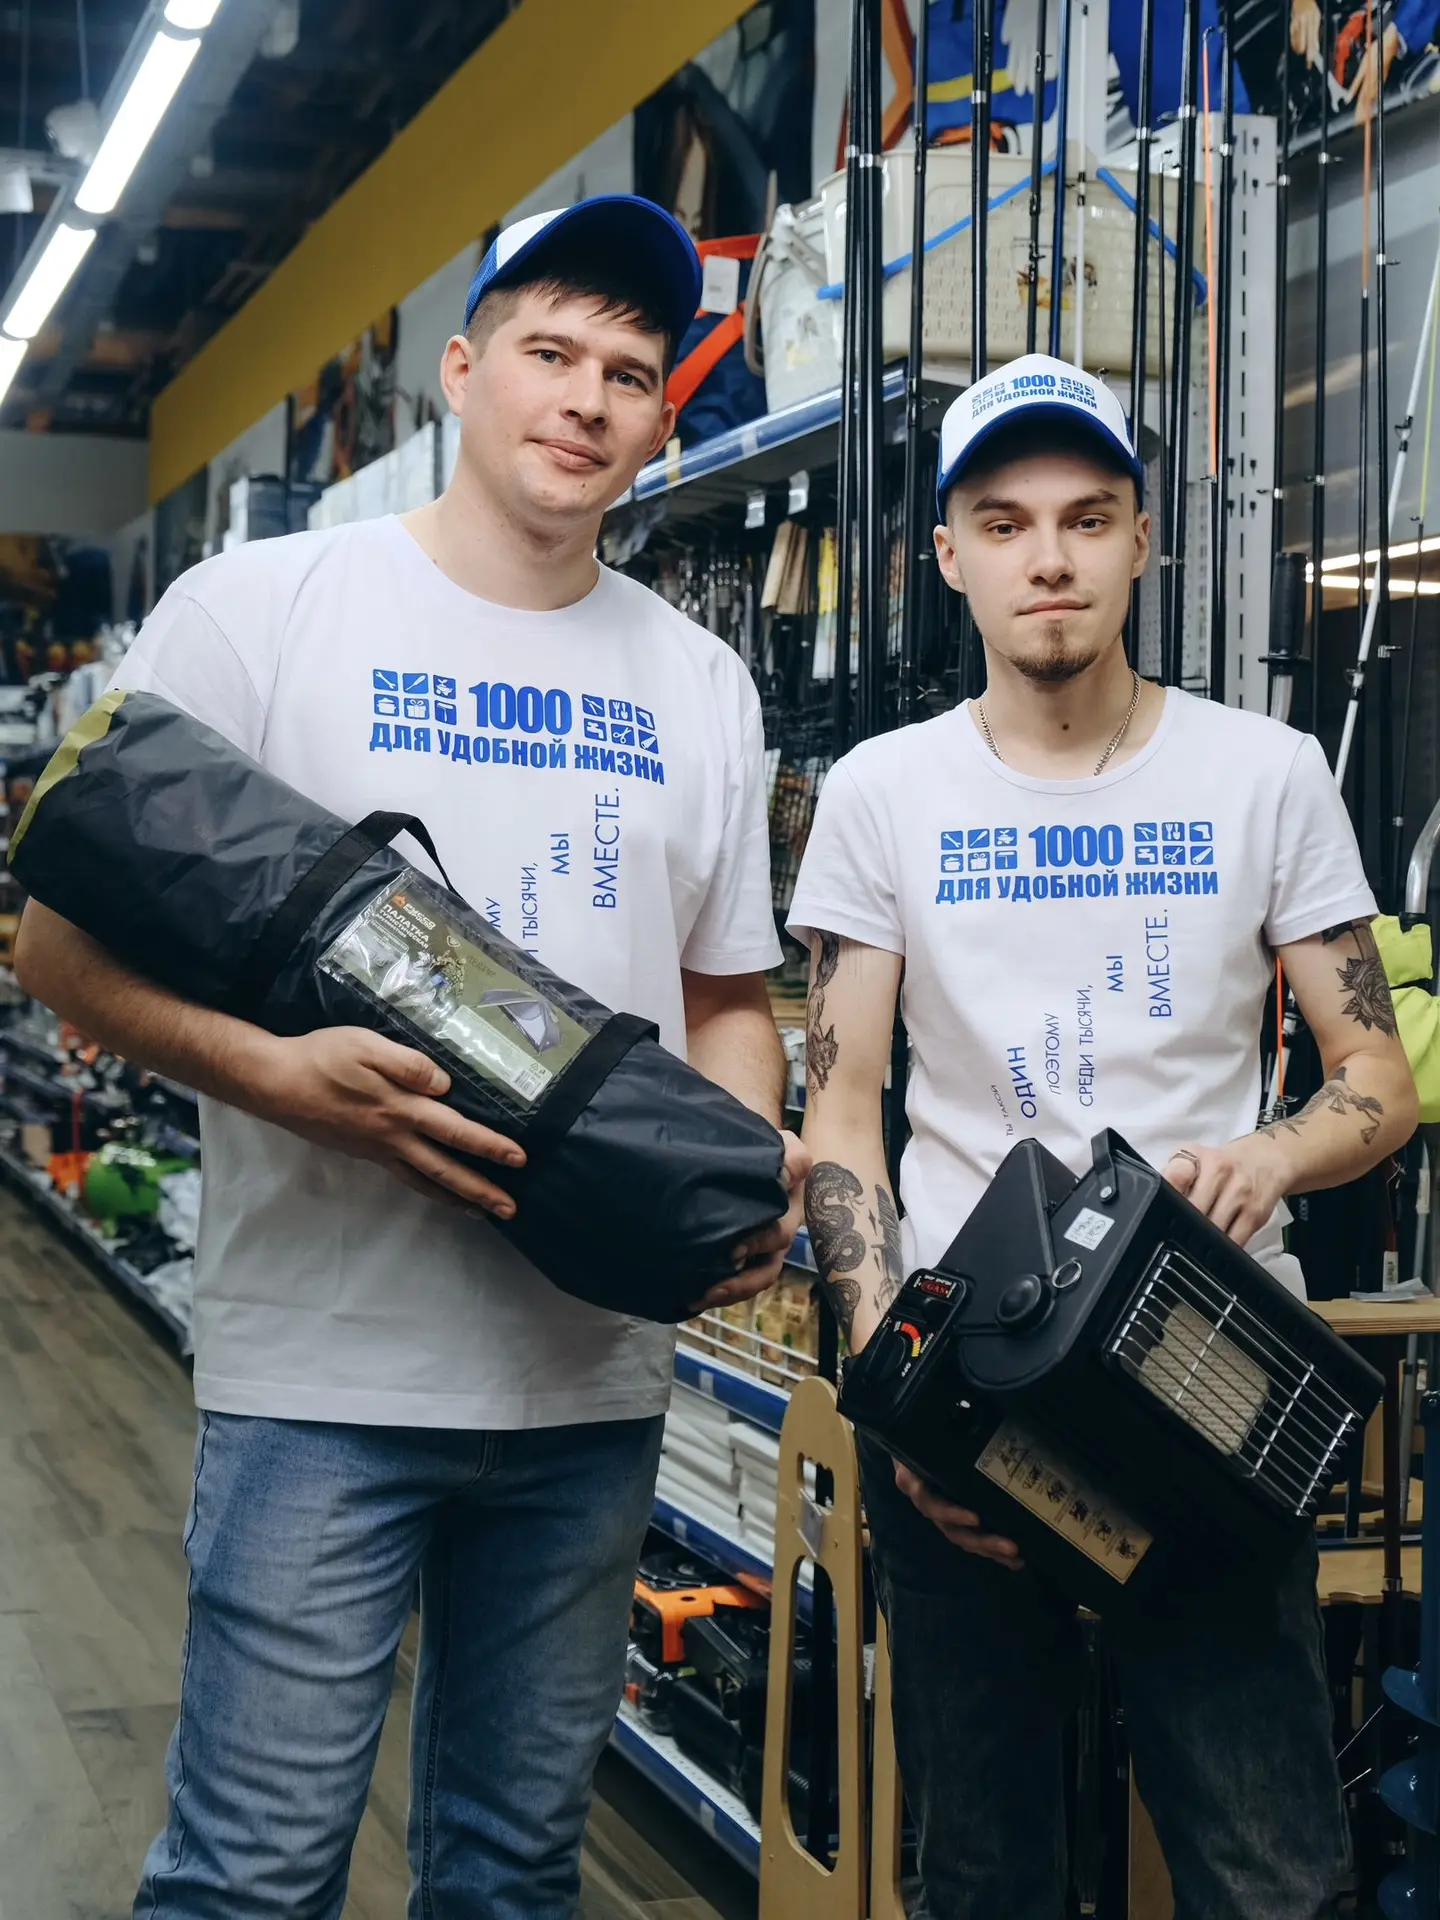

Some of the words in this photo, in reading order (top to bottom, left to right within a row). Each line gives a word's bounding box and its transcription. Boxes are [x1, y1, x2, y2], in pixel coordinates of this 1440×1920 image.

[971, 400, 994, 419] ДЛЯ
[997, 387, 1055, 405] УДОБНОЙ
[1057, 390, 1098, 410] ЖИЗНИ
[1010, 374, 1056, 390] 1000
[468, 681, 573, 736] 1000
[369, 722, 431, 752] ДЛЯ
[438, 729, 567, 768] УДОБНОЙ
[574, 743, 665, 786] ЖИЗНИ
[550, 833, 570, 875] МЫ
[593, 787, 620, 908] ВМЕСТЕ.
[1028, 824, 1123, 868] 1000
[521, 862, 539, 939] ТЫСЯЧИ,
[935, 877, 991, 904] ДЛЯ
[996, 869, 1119, 903] УДОБНОЙ
[1125, 871, 1219, 896] ЖИЗНИ
[382, 904, 429, 943] ПАЛАТКА
[1106, 955, 1125, 993] МЫ
[1145, 908, 1172, 1018] ВМЕСТЕ.
[1076, 984, 1094, 1046] ТЫСЯЧИ,
[1007, 1046, 1037, 1119] ОДИН
[1078, 1054, 1094, 1107] СРЕДИ
